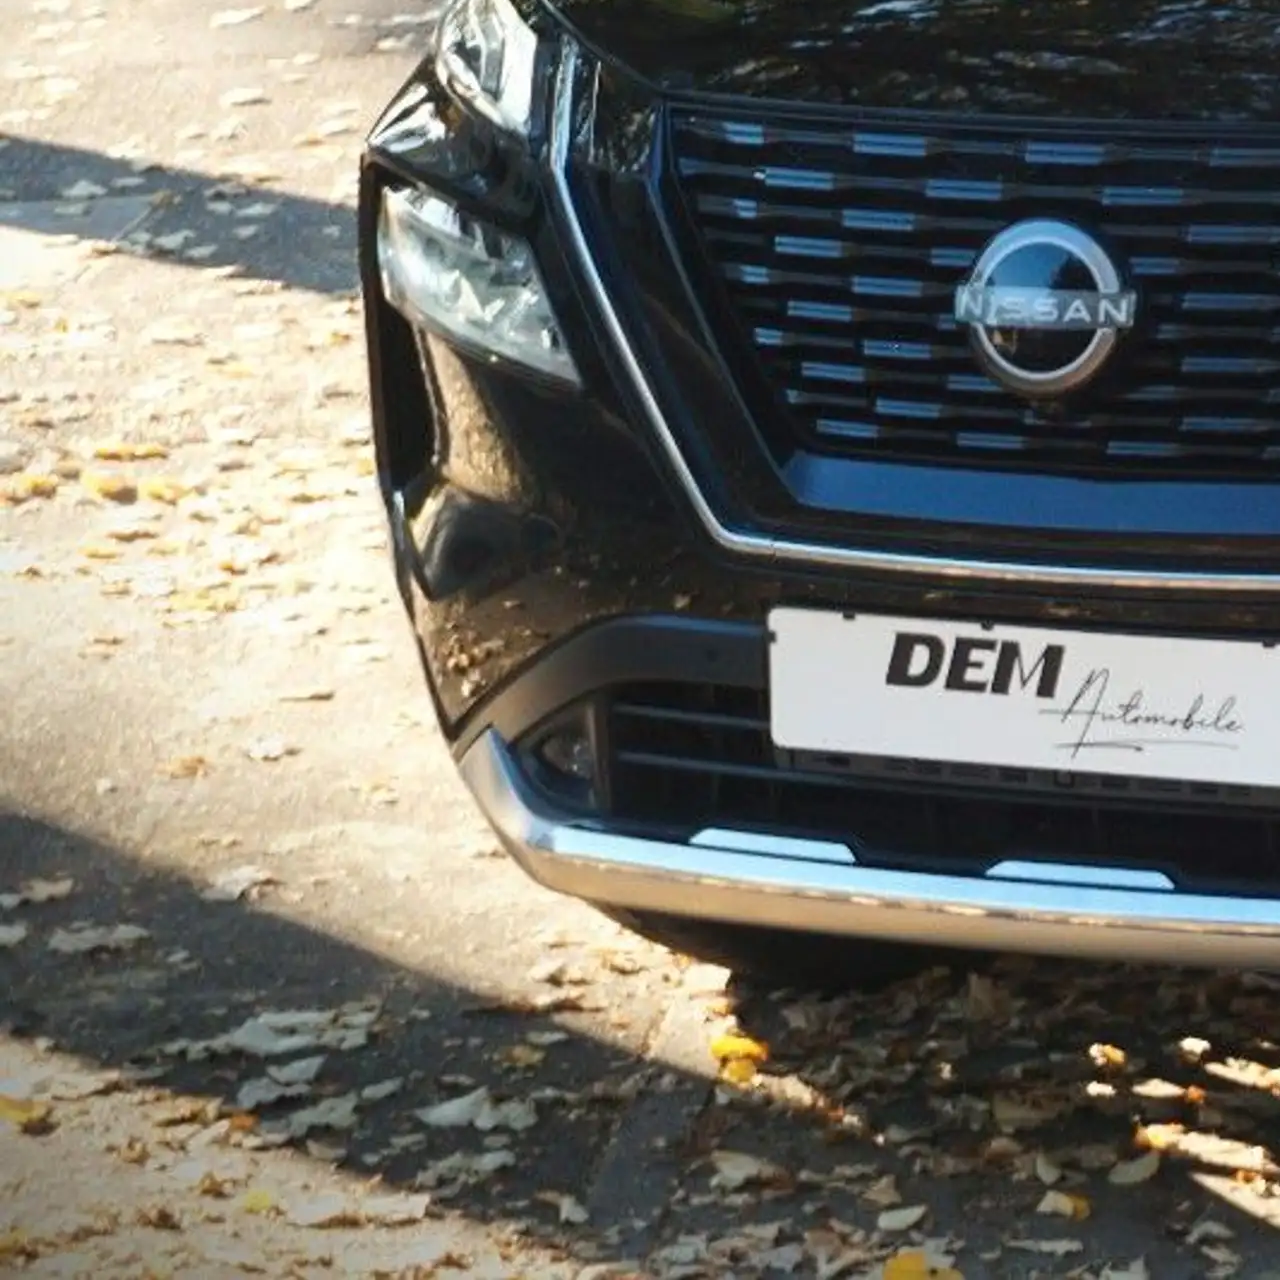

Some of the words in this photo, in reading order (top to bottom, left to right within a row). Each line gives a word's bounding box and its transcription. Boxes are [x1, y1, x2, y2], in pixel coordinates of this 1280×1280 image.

[956, 288, 1130, 324] NISSAN
[886, 632, 1065, 698] DEM
[1039, 668, 1242, 758] Automobile
